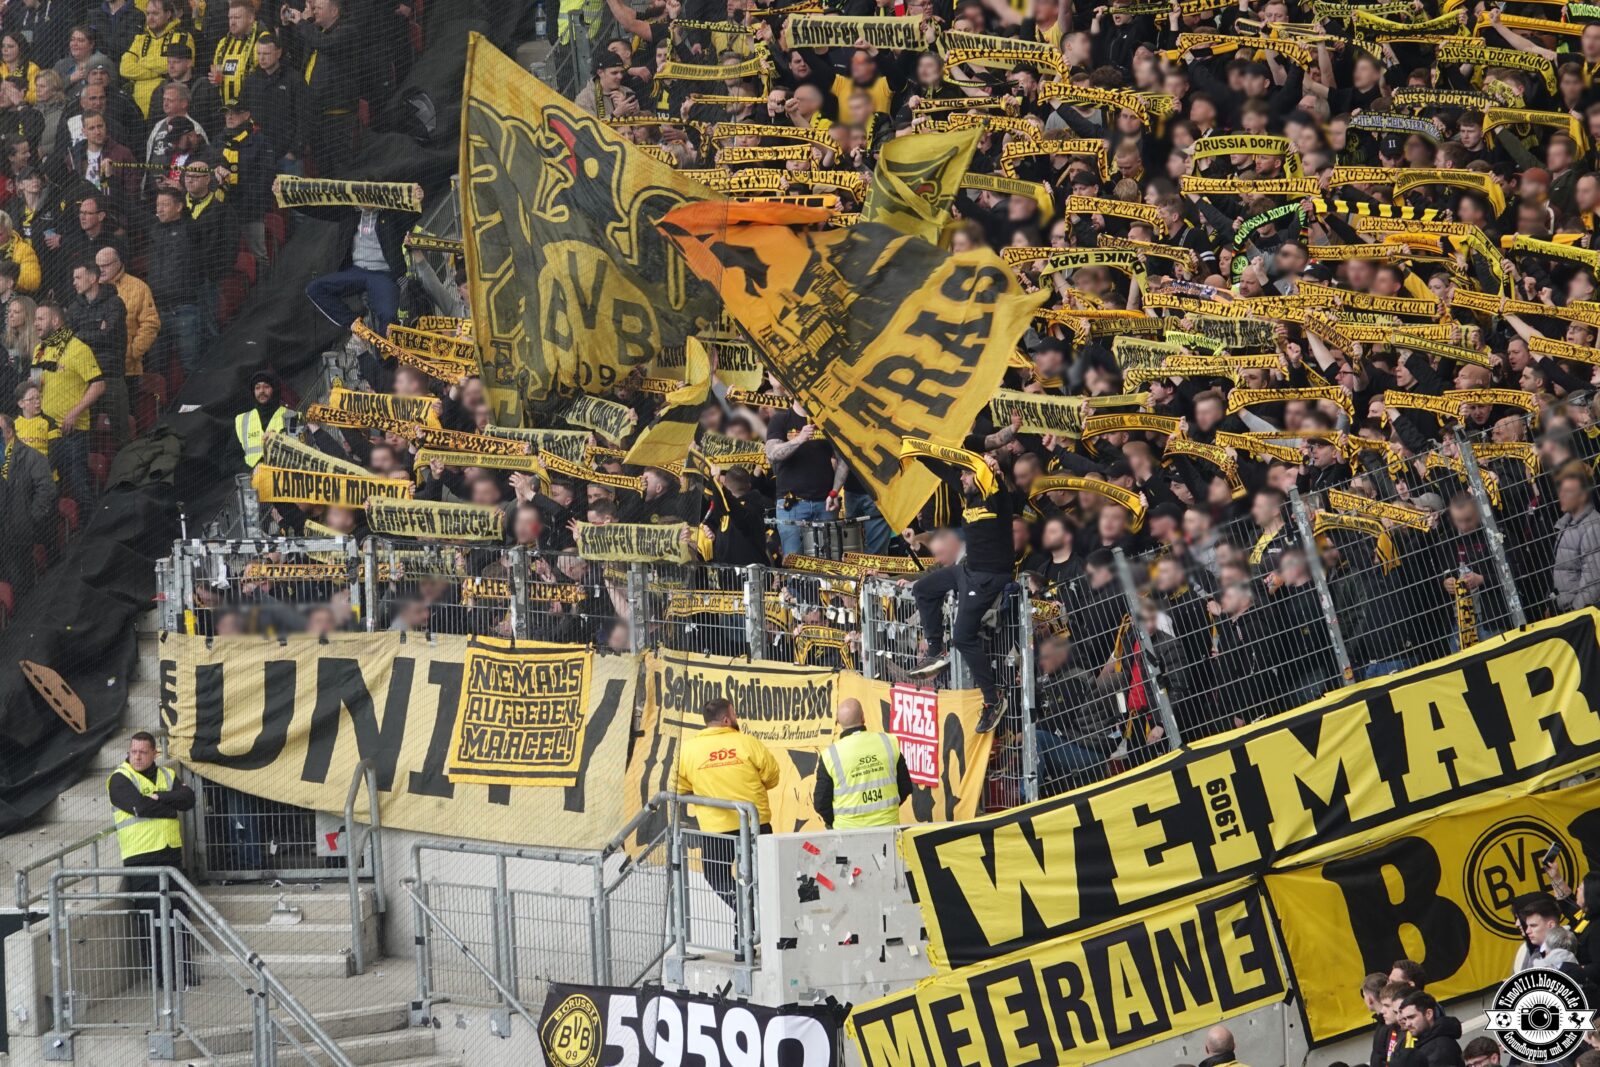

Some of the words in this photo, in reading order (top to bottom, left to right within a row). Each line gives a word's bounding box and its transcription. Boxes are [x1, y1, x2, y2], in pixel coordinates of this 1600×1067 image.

[791, 14, 859, 46] KÄMPFEN
[863, 22, 926, 48] MARCEL!
[1437, 47, 1486, 60] ORUSSIA
[1488, 50, 1550, 72] DORTMUND
[1394, 93, 1436, 105] ORUSSIA
[1050, 253, 1089, 269] PAPA
[1372, 298, 1436, 315] DORTMUND
[390, 330, 431, 352] THE
[320, 407, 348, 423] THE
[422, 430, 451, 446] THE
[438, 508, 499, 537] MARCEL!
[470, 656, 583, 697] NIEMALS
[725, 677, 834, 723] Stadionverbot
[893, 694, 936, 738] FREE
[189, 656, 627, 813] UNIY
[459, 725, 574, 763] MARCEL!
[709, 748, 737, 762] SDS
[859, 754, 878, 766] SDS
[862, 788, 883, 804] 0434
[936, 634, 1600, 948] WEIMAR
[1205, 759, 1242, 845] 1909
[859, 902, 1268, 1067] MEERANE
[553, 997, 600, 1027] BORUSSIA
[557, 1015, 591, 1051] BVB
[565, 1049, 578, 1061] 09
